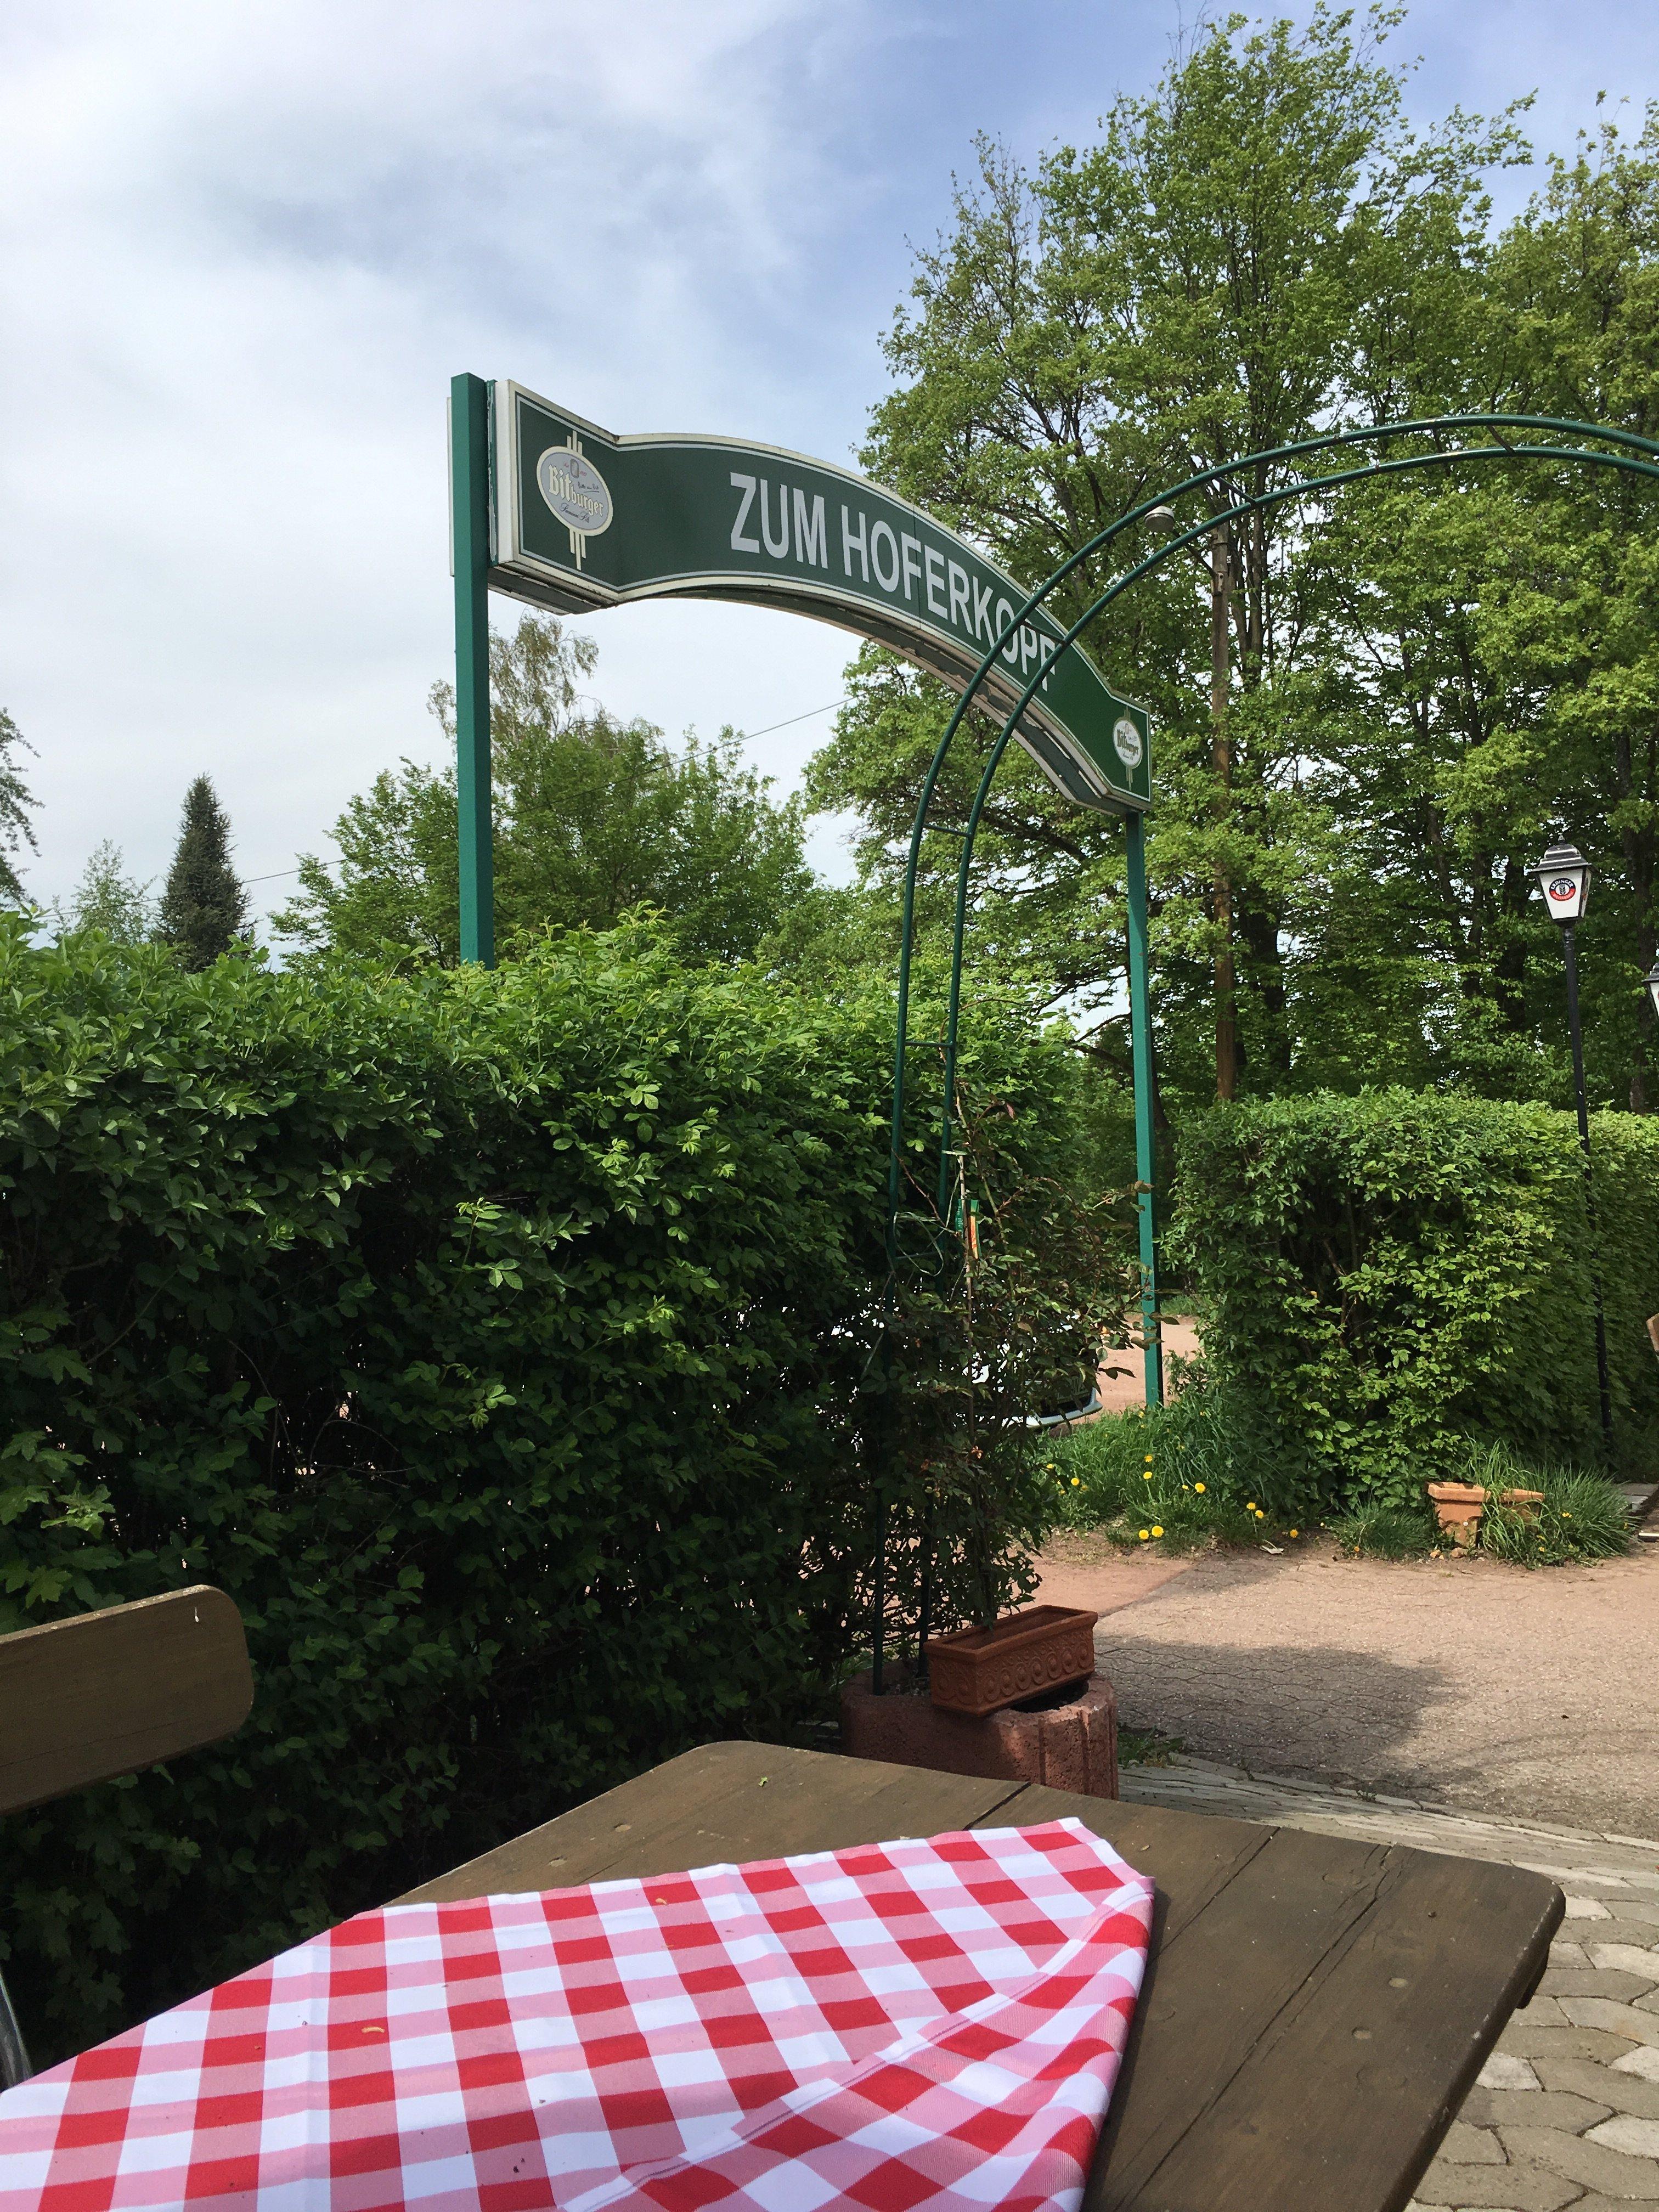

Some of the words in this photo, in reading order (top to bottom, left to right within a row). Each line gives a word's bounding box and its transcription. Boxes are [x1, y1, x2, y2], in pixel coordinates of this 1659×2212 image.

[548, 464, 603, 516] Bitburger
[730, 472, 828, 569] ZUM
[841, 504, 1056, 692] HOFERKOPF
